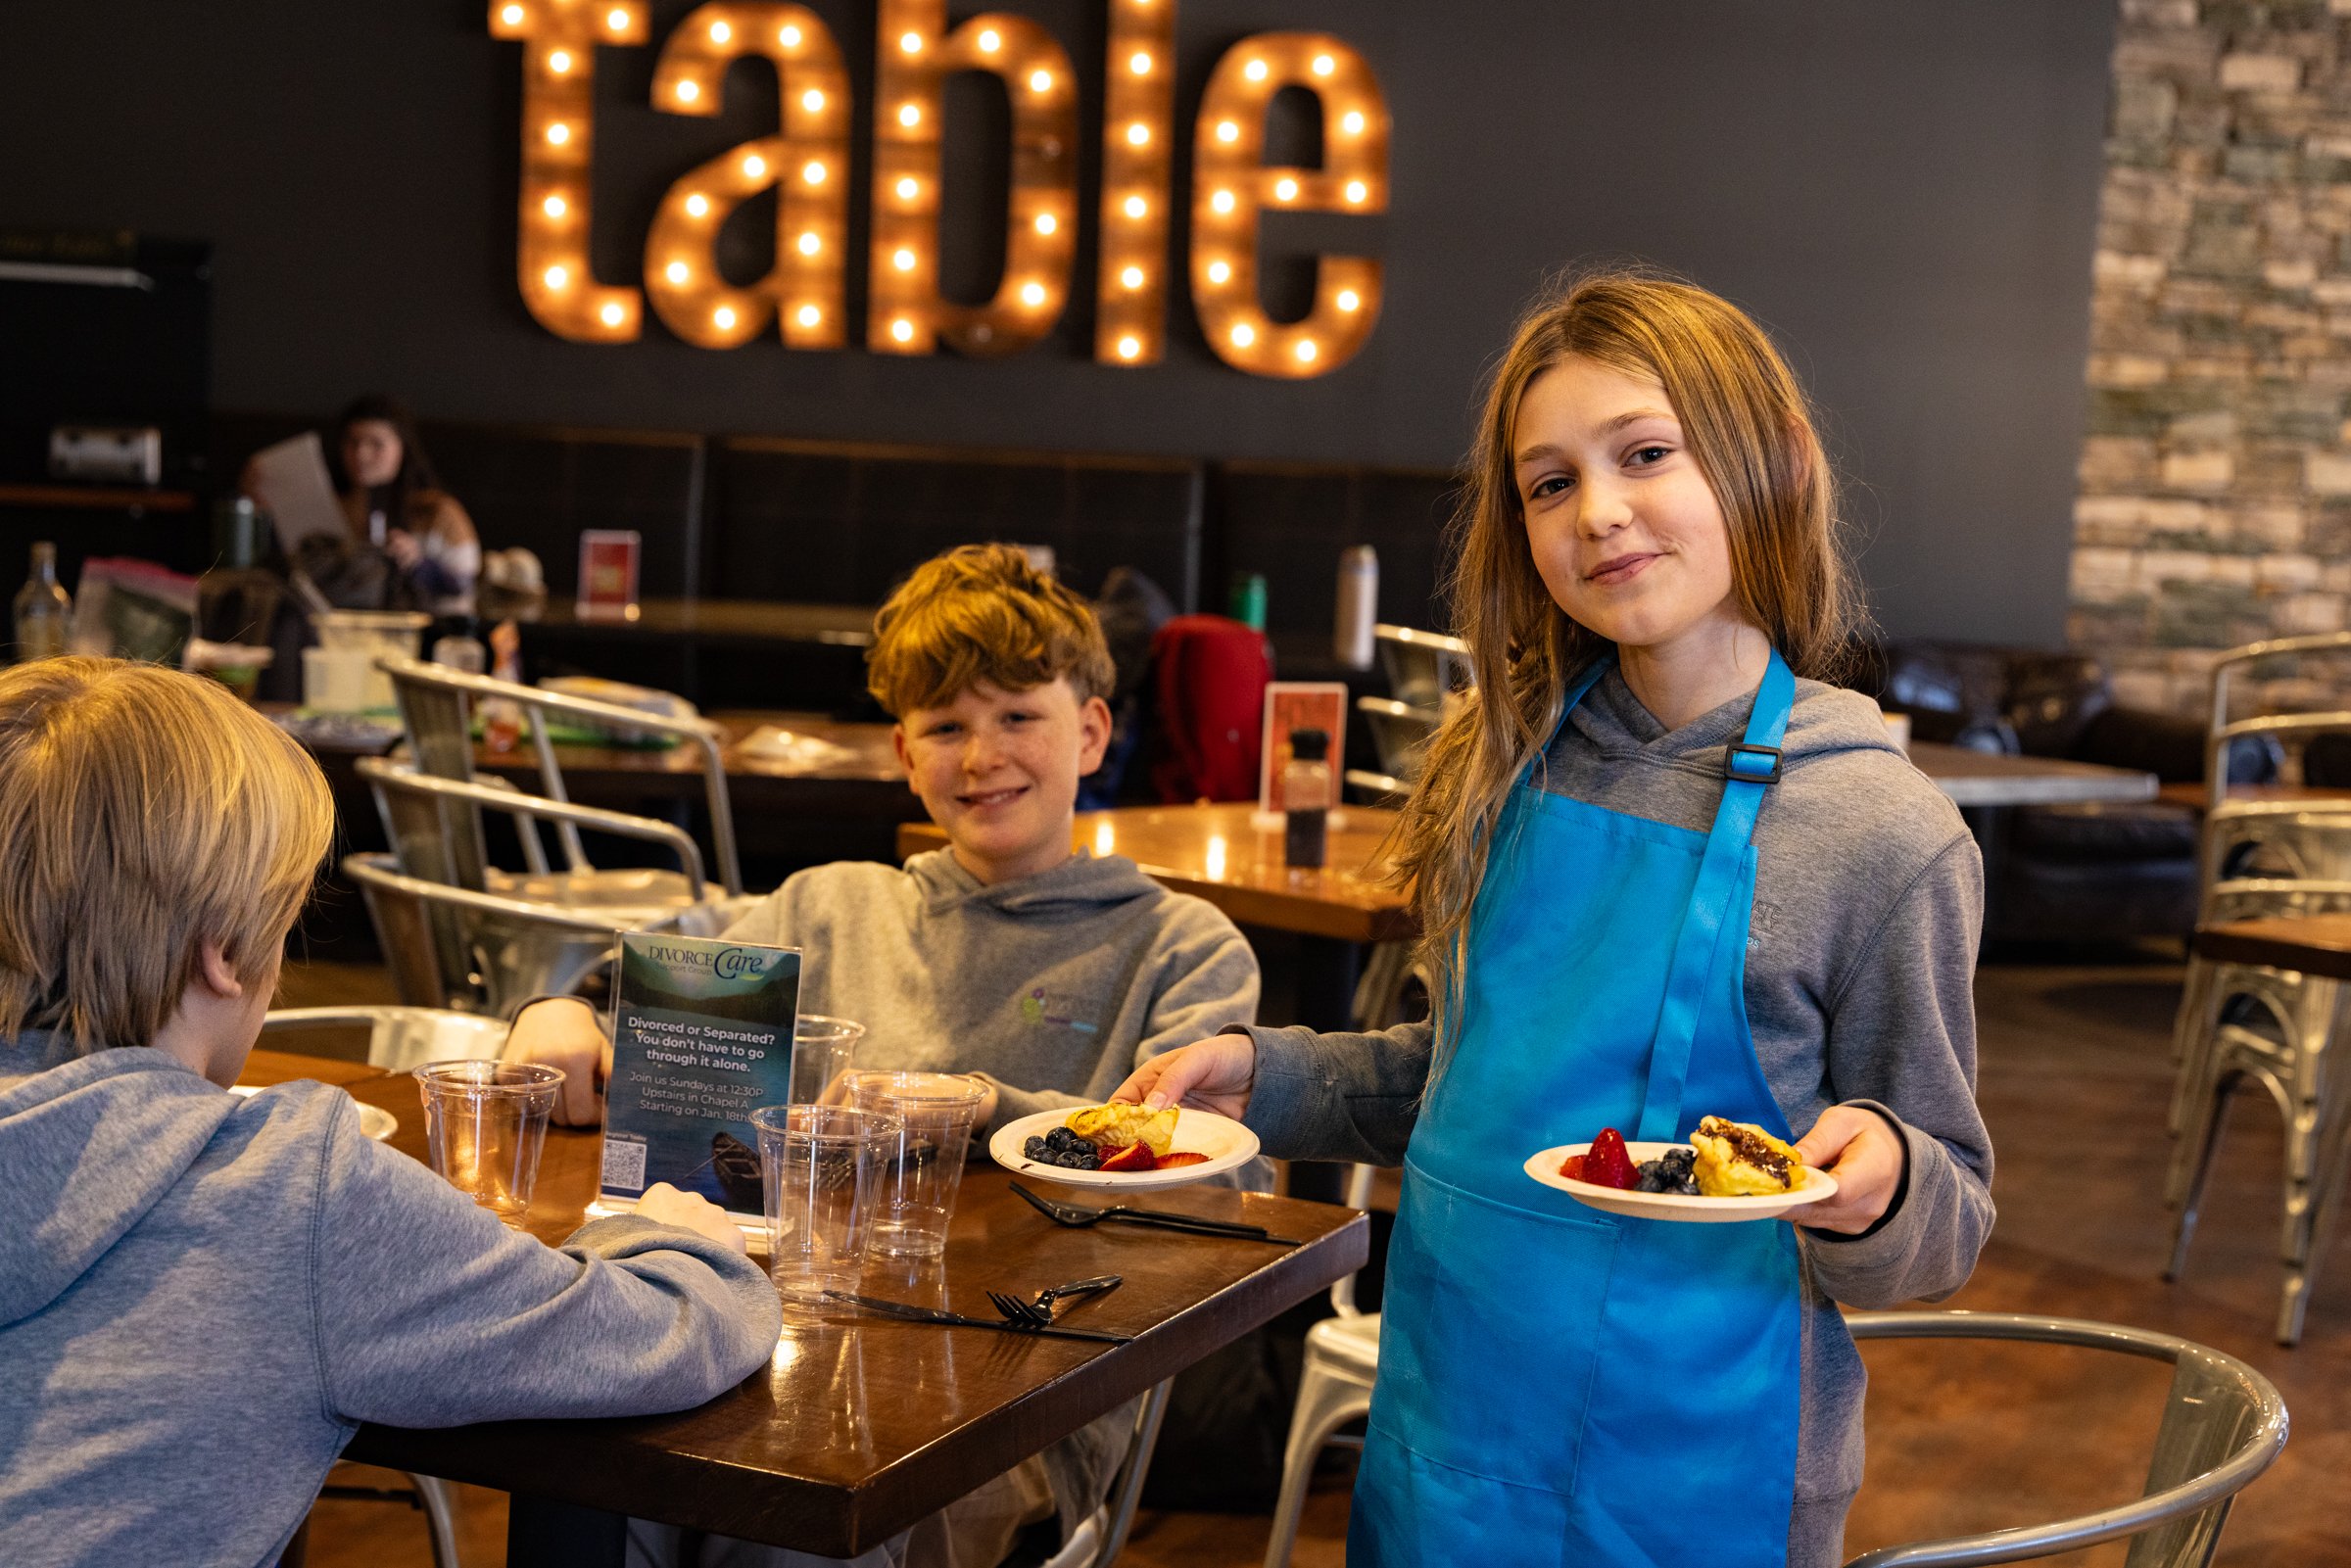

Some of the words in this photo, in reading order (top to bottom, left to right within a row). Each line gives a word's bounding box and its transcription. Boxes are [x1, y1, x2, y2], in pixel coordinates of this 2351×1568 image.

[488, 0, 1393, 380] table
[648, 946, 713, 966] DIVORCE
[714, 947, 763, 979] Care
[688, 966, 712, 977] Group
[628, 1017, 684, 1033] Divorced
[687, 1025, 700, 1035] or
[702, 1026, 776, 1046] Separated?
[637, 1032, 659, 1046] You
[662, 1035, 695, 1049] don't
[697, 1040, 729, 1055] have
[732, 1045, 745, 1057] to
[747, 1048, 765, 1061] go
[647, 1048, 697, 1067] through
[699, 1055, 710, 1068] it
[712, 1058, 751, 1072] alone.
[630, 1071, 652, 1084] Join
[654, 1076, 667, 1086] us
[669, 1076, 715, 1093] Sundays
[716, 1084, 728, 1093] at
[730, 1084, 764, 1098] 12:30P
[640, 1099, 683, 1117] Starting
[685, 1107, 699, 1116] on
[700, 1108, 723, 1119] Jan.
[642, 1087, 686, 1102] Upstairs
[688, 1092, 698, 1103] in
[699, 1094, 739, 1109] Chapel
[740, 1099, 749, 1110] A
